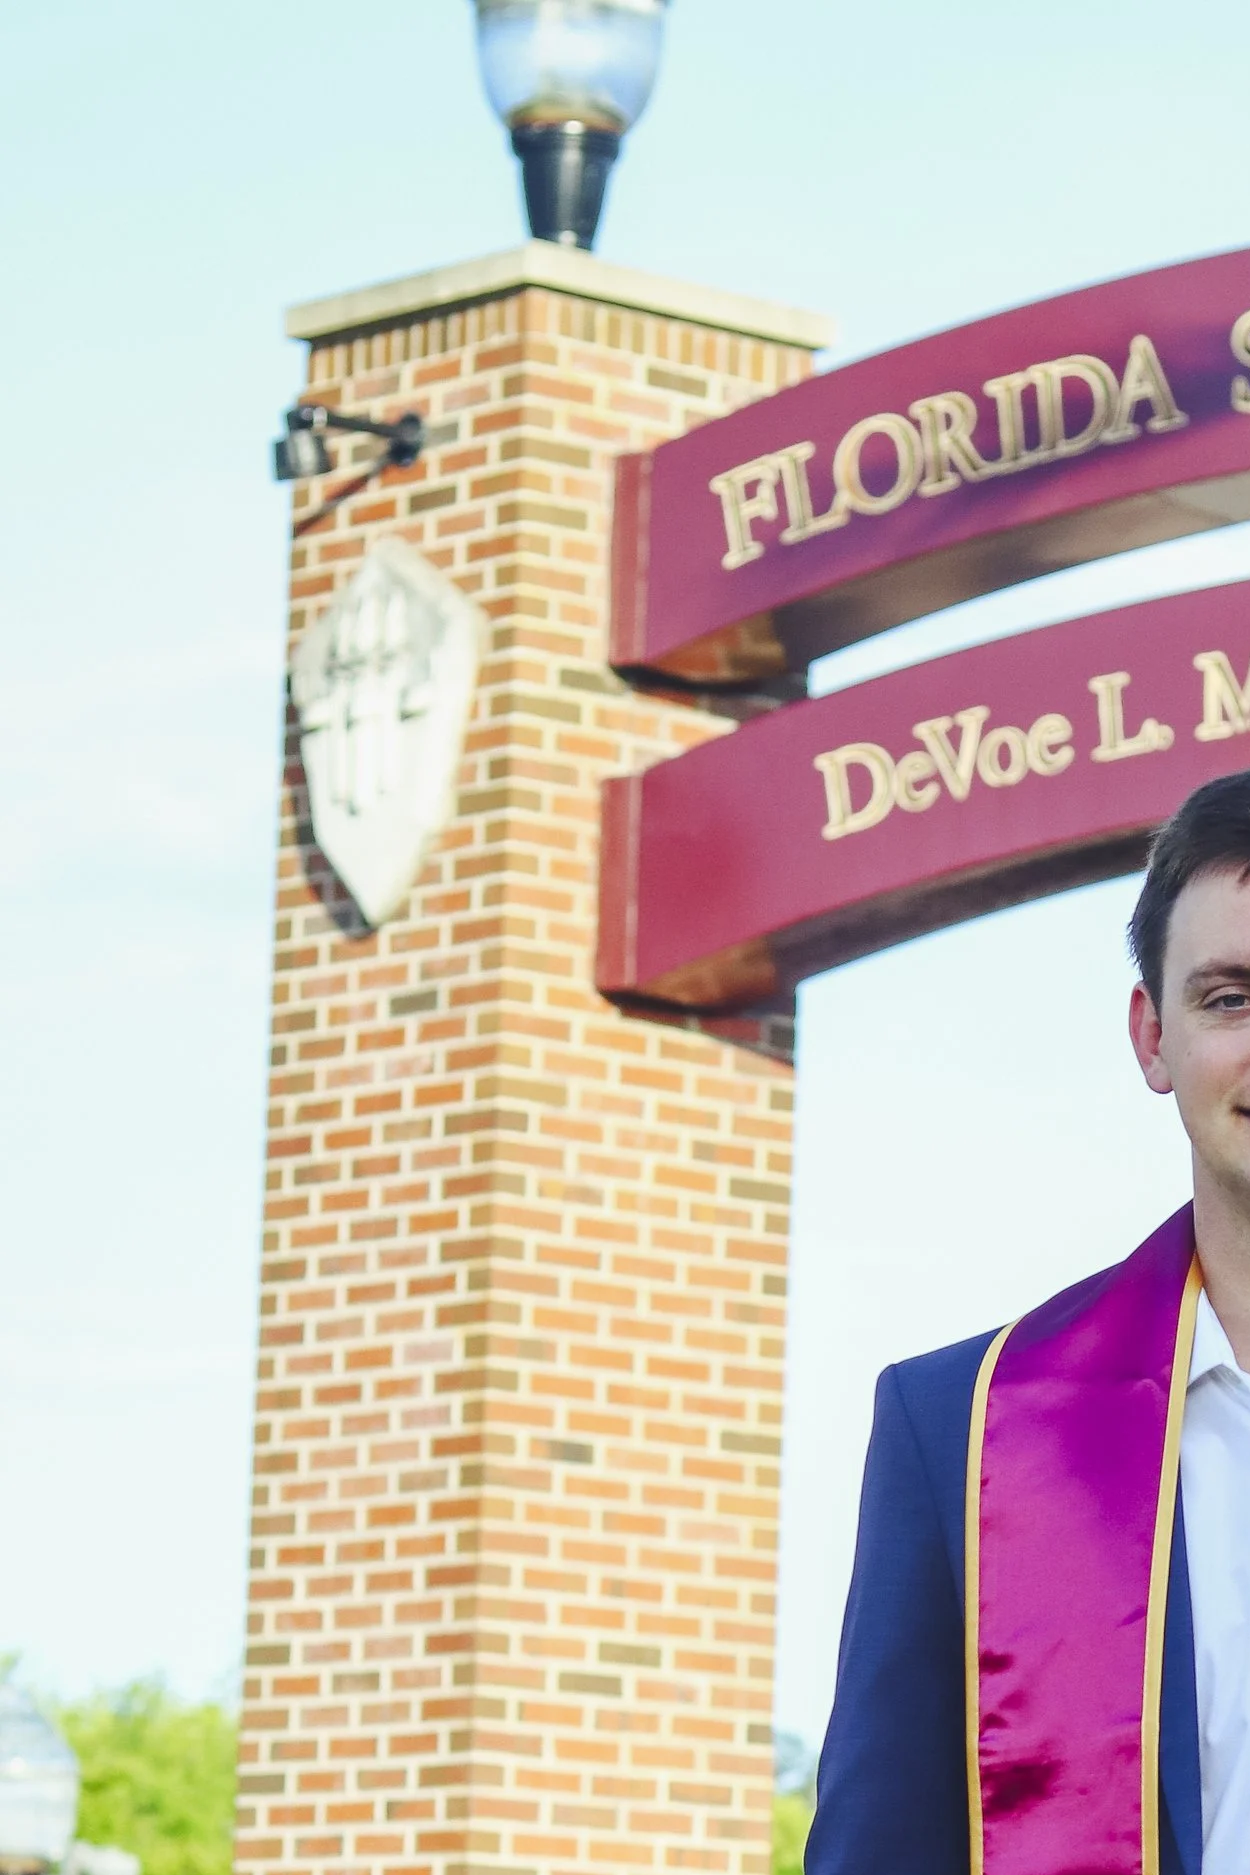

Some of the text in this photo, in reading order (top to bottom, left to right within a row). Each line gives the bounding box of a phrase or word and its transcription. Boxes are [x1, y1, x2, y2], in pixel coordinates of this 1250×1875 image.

[709, 334, 1189, 572] FLORIDA
[813, 705, 1075, 841] DeVoe
[1087, 672, 1175, 763] L.
